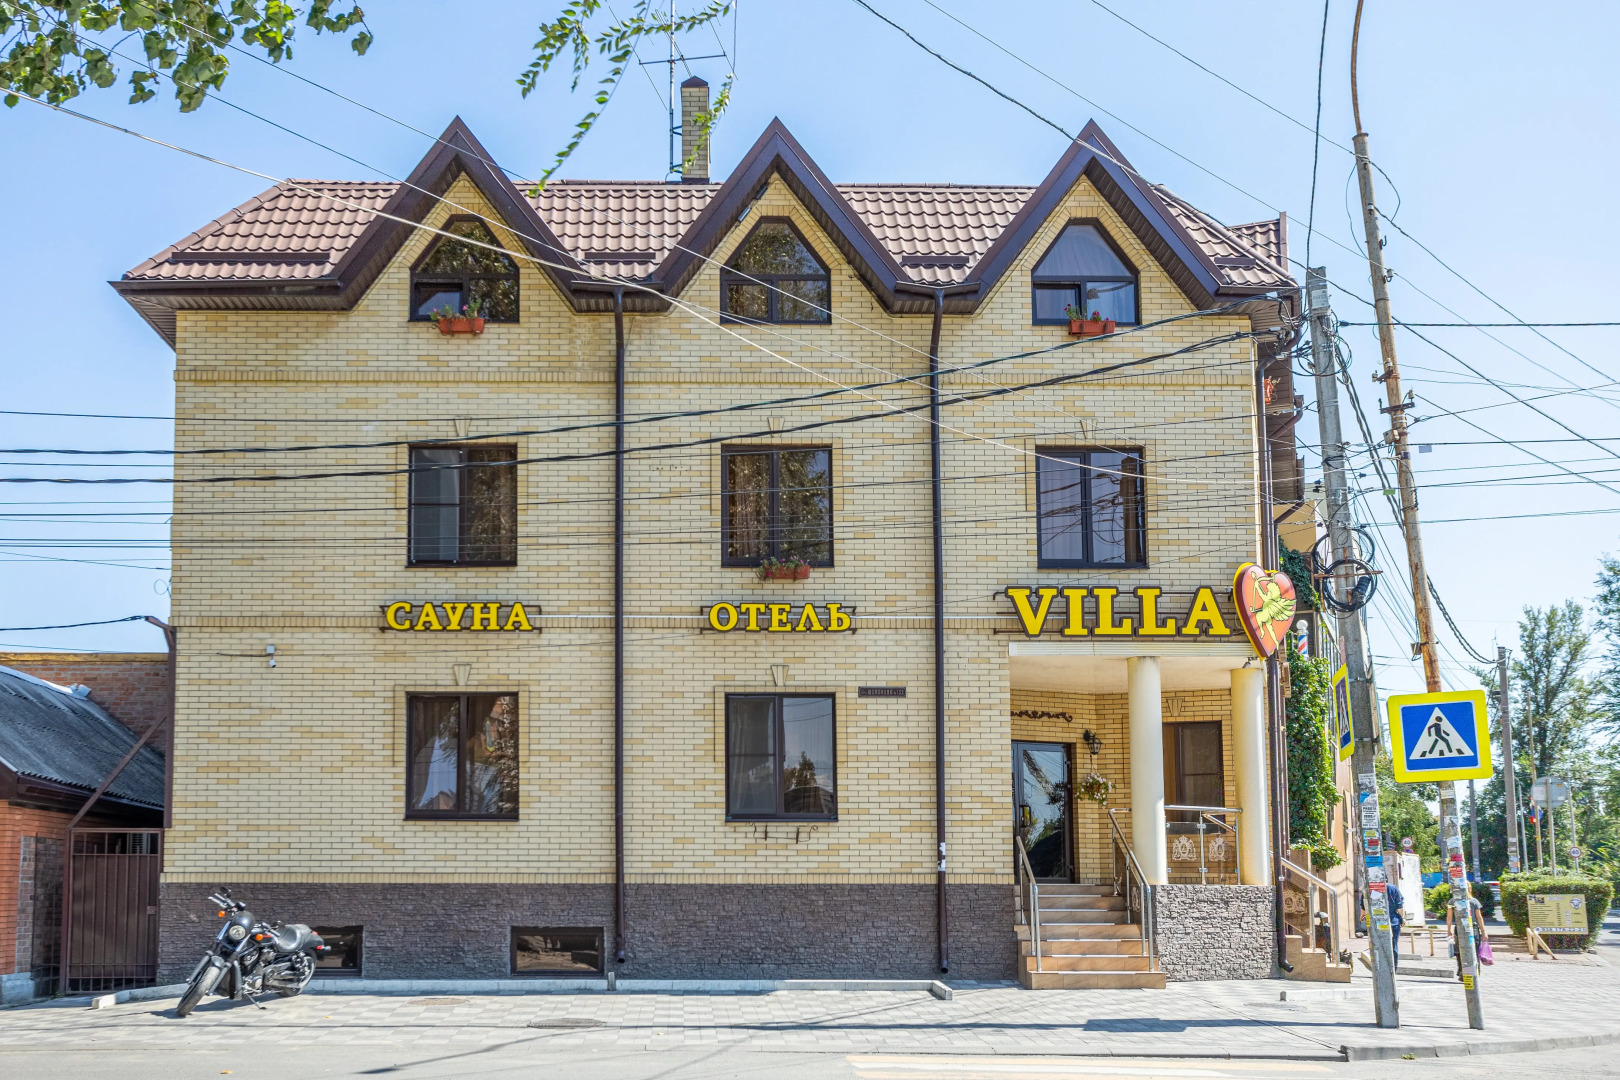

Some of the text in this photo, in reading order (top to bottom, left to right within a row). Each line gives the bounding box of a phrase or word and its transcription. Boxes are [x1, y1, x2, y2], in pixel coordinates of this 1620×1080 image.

[385, 601, 534, 632] САУНА
[708, 601, 852, 632] ОТЕЛЬ
[1005, 586, 1234, 638] VILLA
